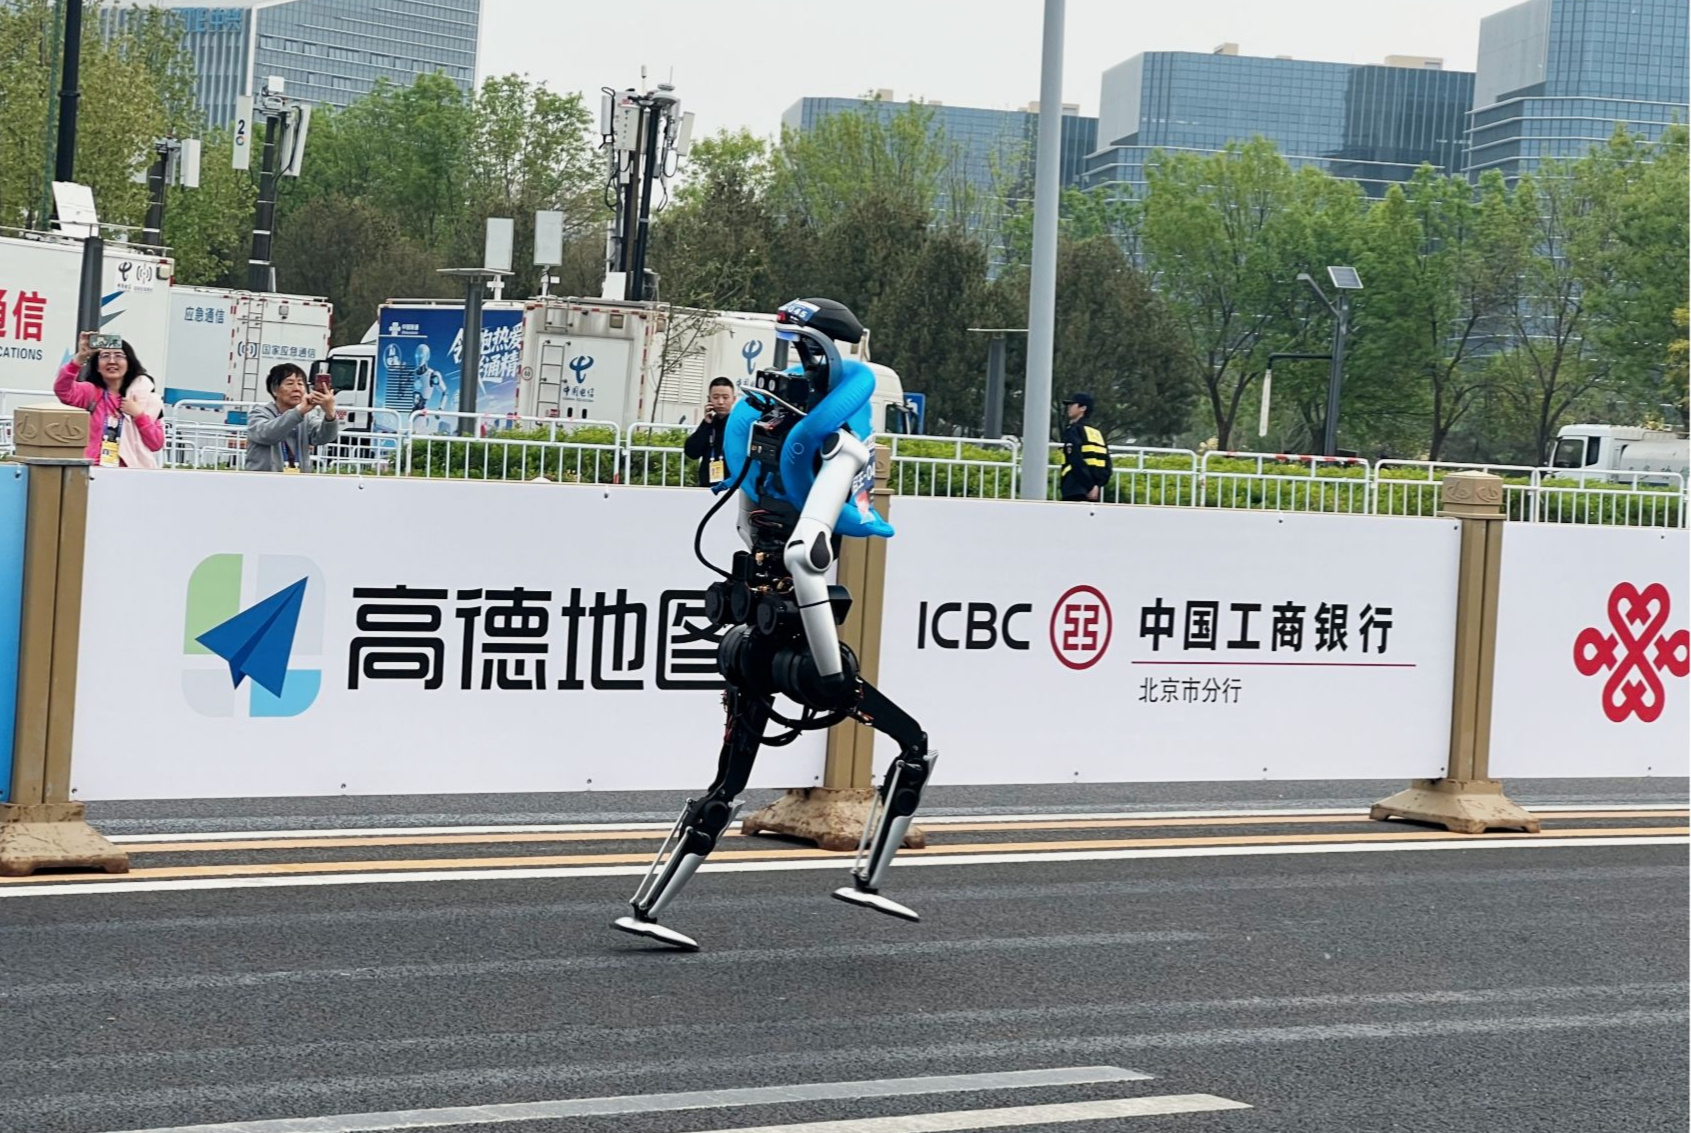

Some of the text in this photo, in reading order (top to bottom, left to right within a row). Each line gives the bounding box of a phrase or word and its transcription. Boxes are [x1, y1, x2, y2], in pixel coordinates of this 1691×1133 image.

[238, 119, 245, 135] 2
[0, 289, 47, 341] 信
[184, 306, 225, 324] 应急通信
[261, 343, 317, 359] 国家应急通信
[347, 584, 731, 690] 高德地图
[917, 601, 1033, 650] ICBC
[1139, 597, 1394, 655] 中国工商银行
[1138, 676, 1243, 705] 北京市分行
